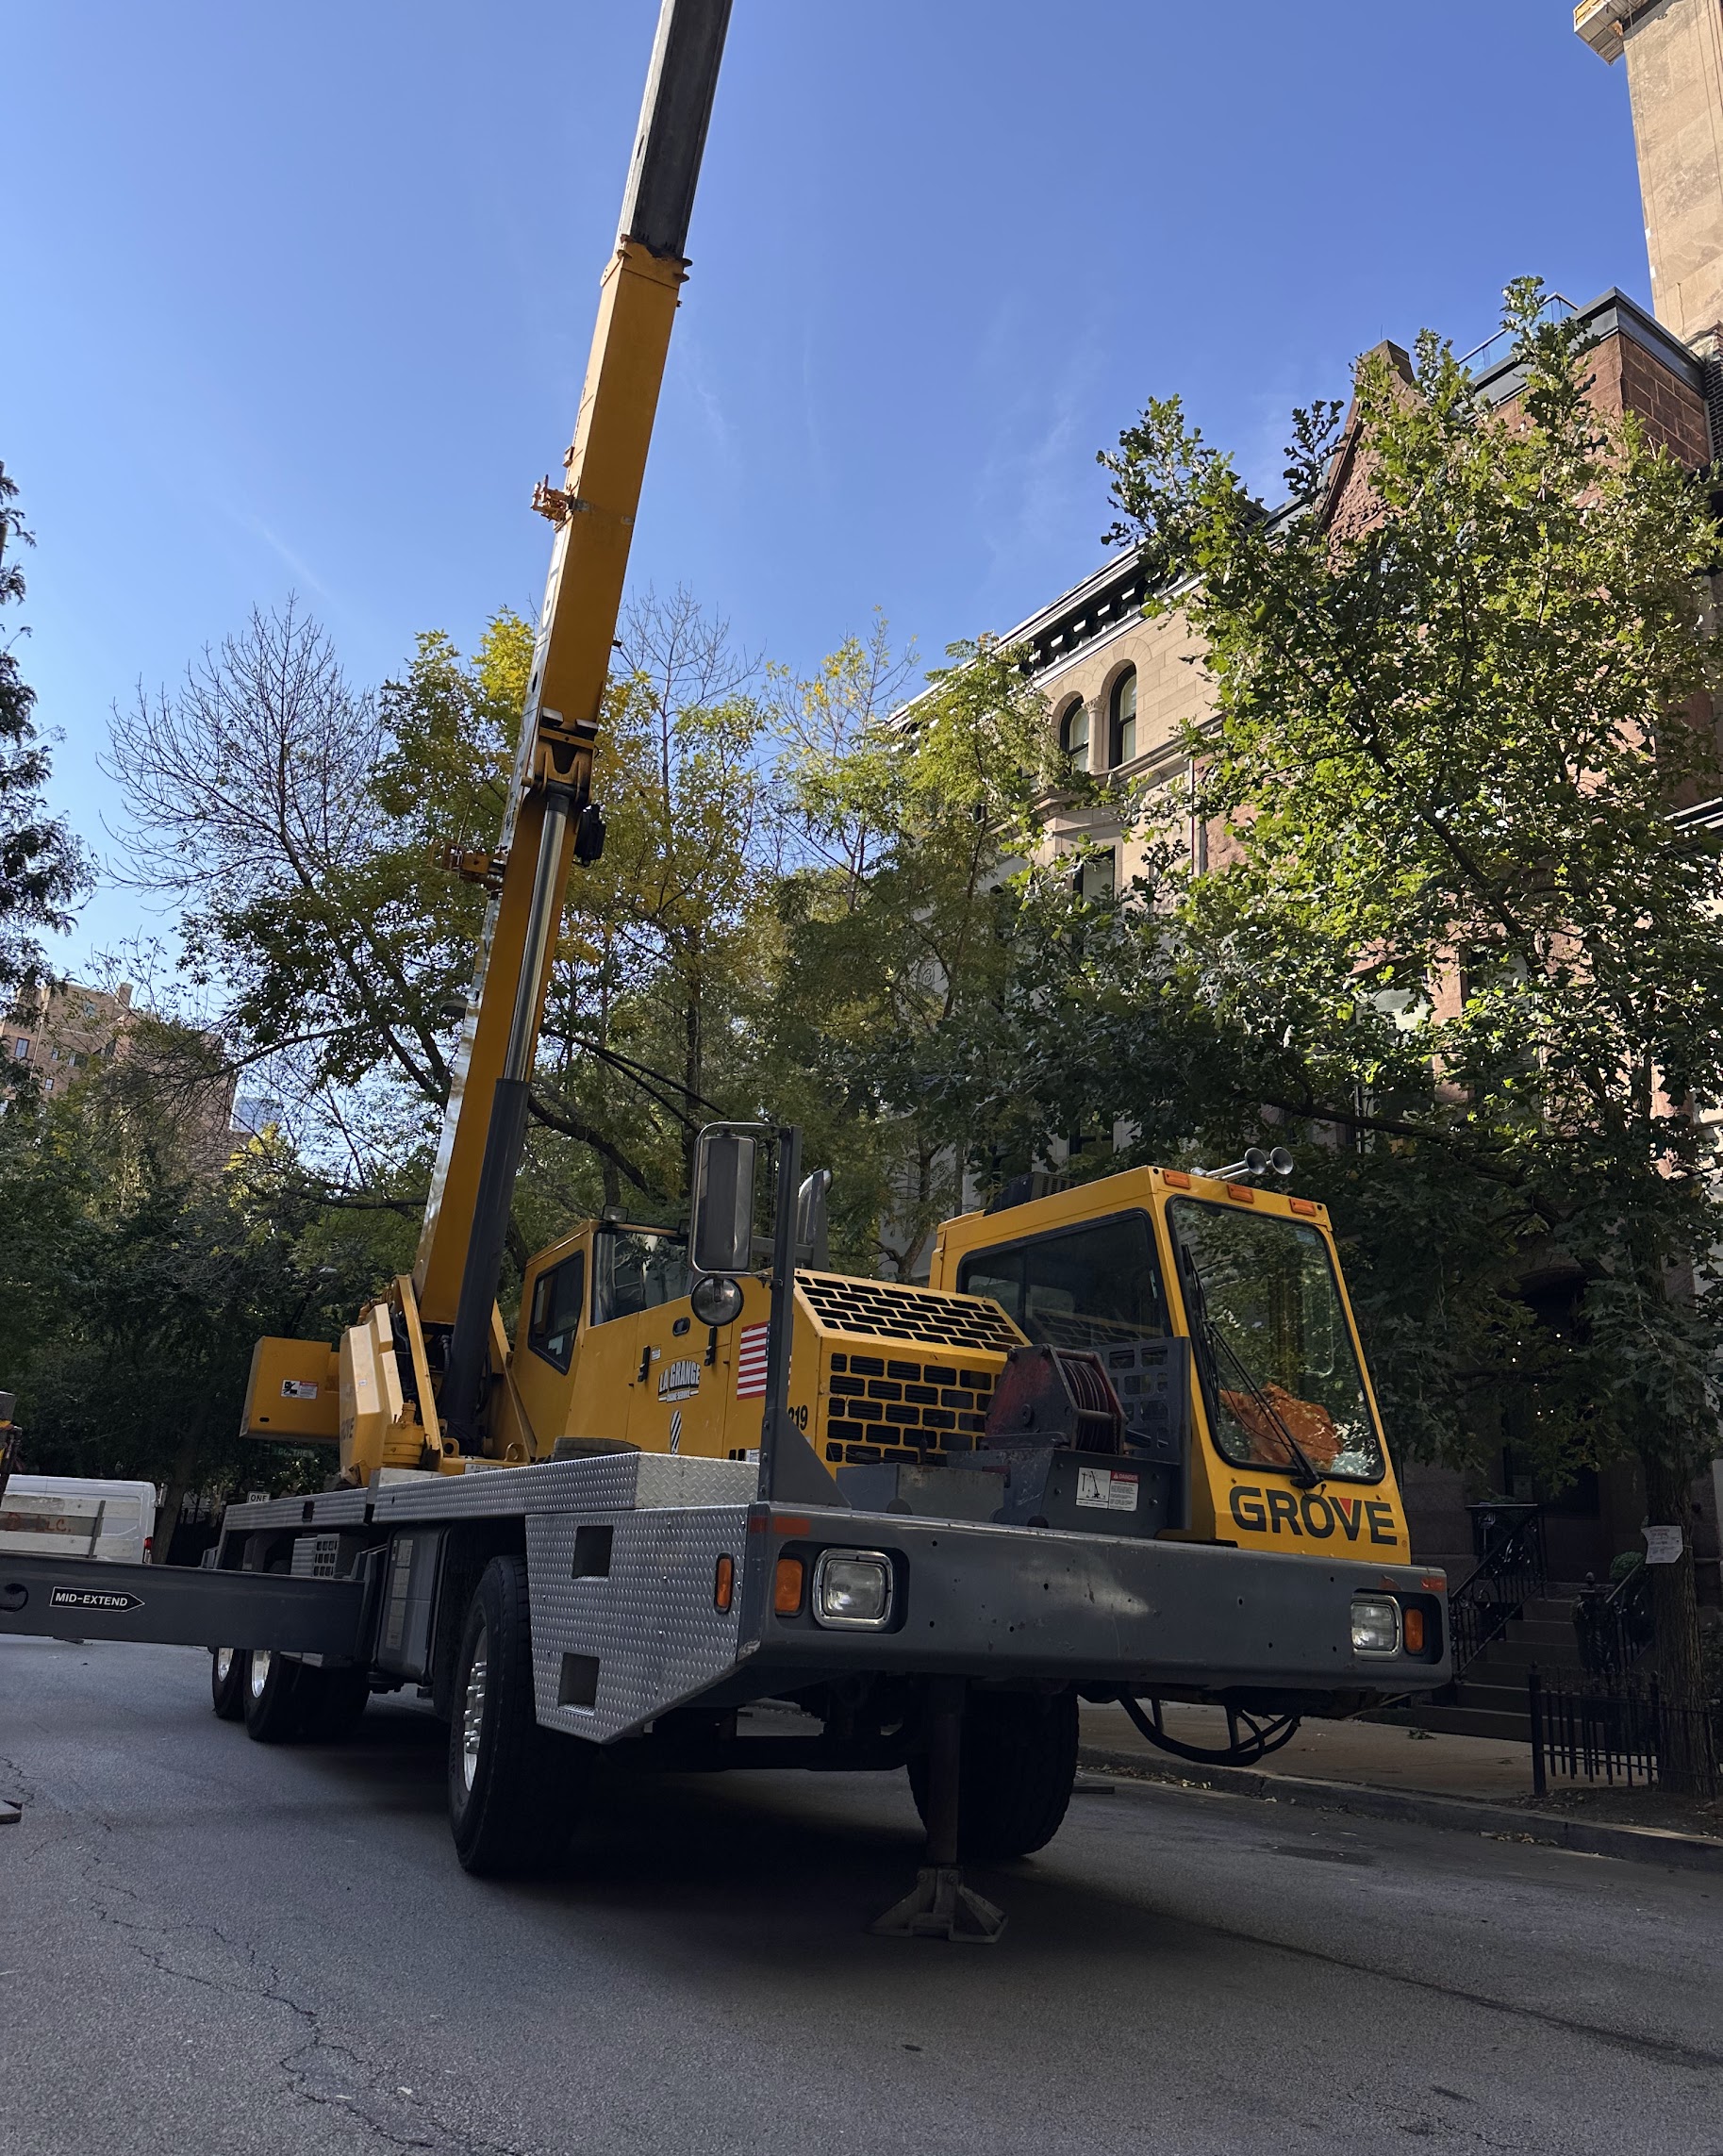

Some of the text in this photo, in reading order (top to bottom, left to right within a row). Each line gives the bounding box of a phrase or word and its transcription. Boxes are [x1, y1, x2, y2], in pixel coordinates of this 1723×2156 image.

[659, 1360, 701, 1393] LA GRANGE
[250, 1494, 268, 1502] ONE
[1230, 1485, 1398, 1546] GROVE
[55, 1592, 128, 1607] MID-EXTEND
